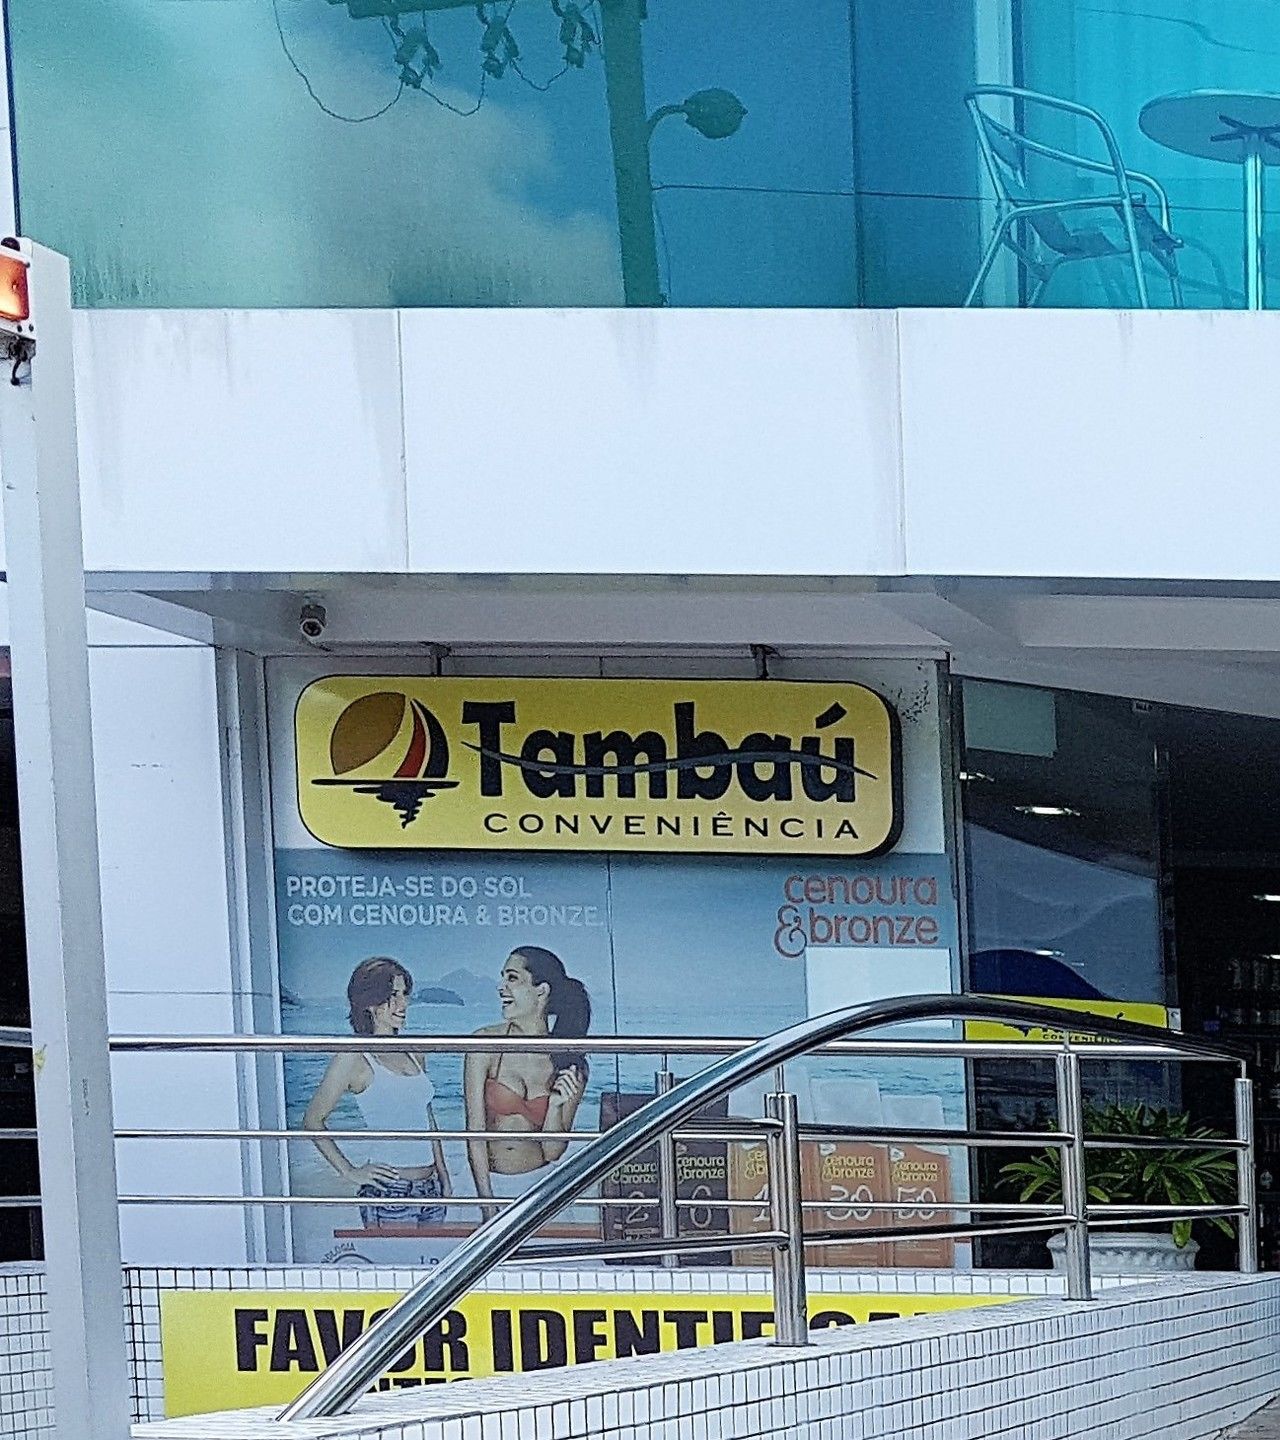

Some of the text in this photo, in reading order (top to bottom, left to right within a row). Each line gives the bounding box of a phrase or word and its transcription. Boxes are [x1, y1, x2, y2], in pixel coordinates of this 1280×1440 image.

[462, 700, 857, 803] Tambaú
[484, 811, 859, 839] CONVENIÊNCIA
[286, 875, 532, 898] PROTEJA-SE DO SOL
[784, 874, 938, 905] cenoura
[287, 904, 342, 926] COM
[349, 904, 467, 926] CENOURA
[475, 905, 491, 926] &
[826, 1184, 874, 1221] 30
[896, 1187, 938, 1220] 50
